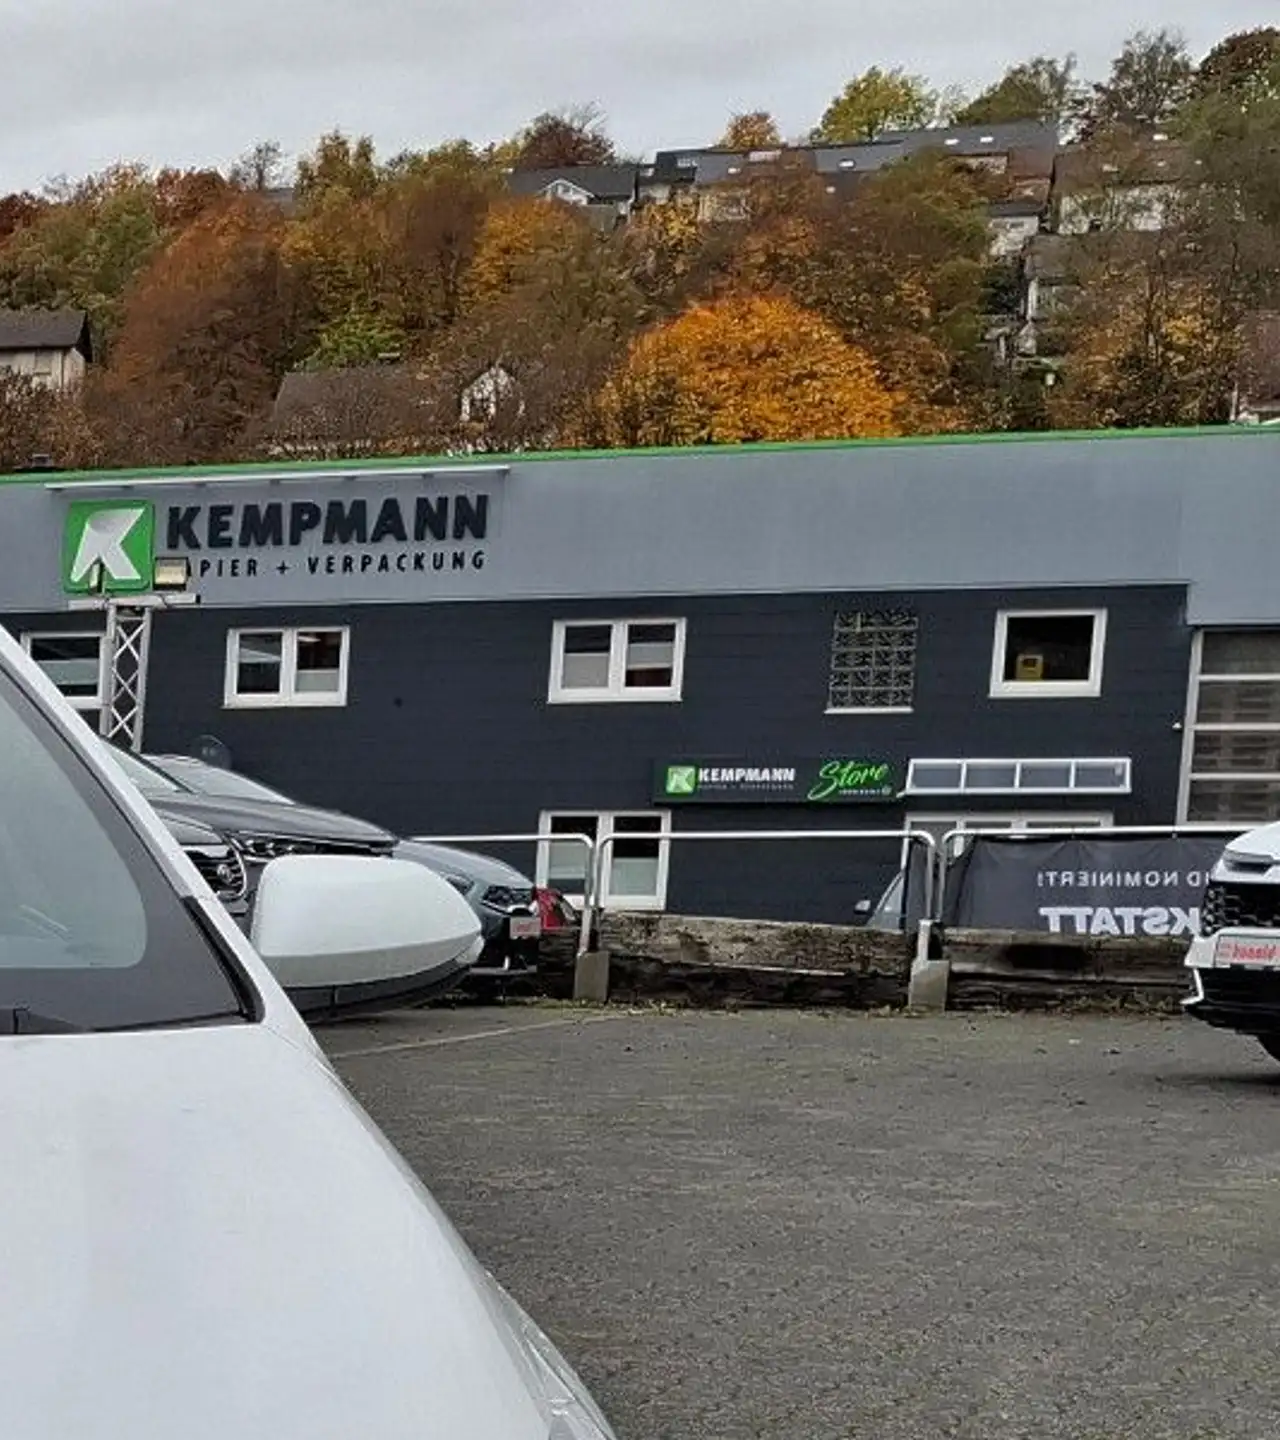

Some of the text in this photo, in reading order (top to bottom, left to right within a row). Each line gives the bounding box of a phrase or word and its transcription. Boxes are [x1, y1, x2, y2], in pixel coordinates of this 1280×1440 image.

[166, 494, 490, 550] KEMPMANN
[187, 558, 258, 578] PIER
[307, 549, 487, 576] VERPACKUNG
[697, 767, 796, 782] KEMPMANN
[807, 760, 889, 801] Store
